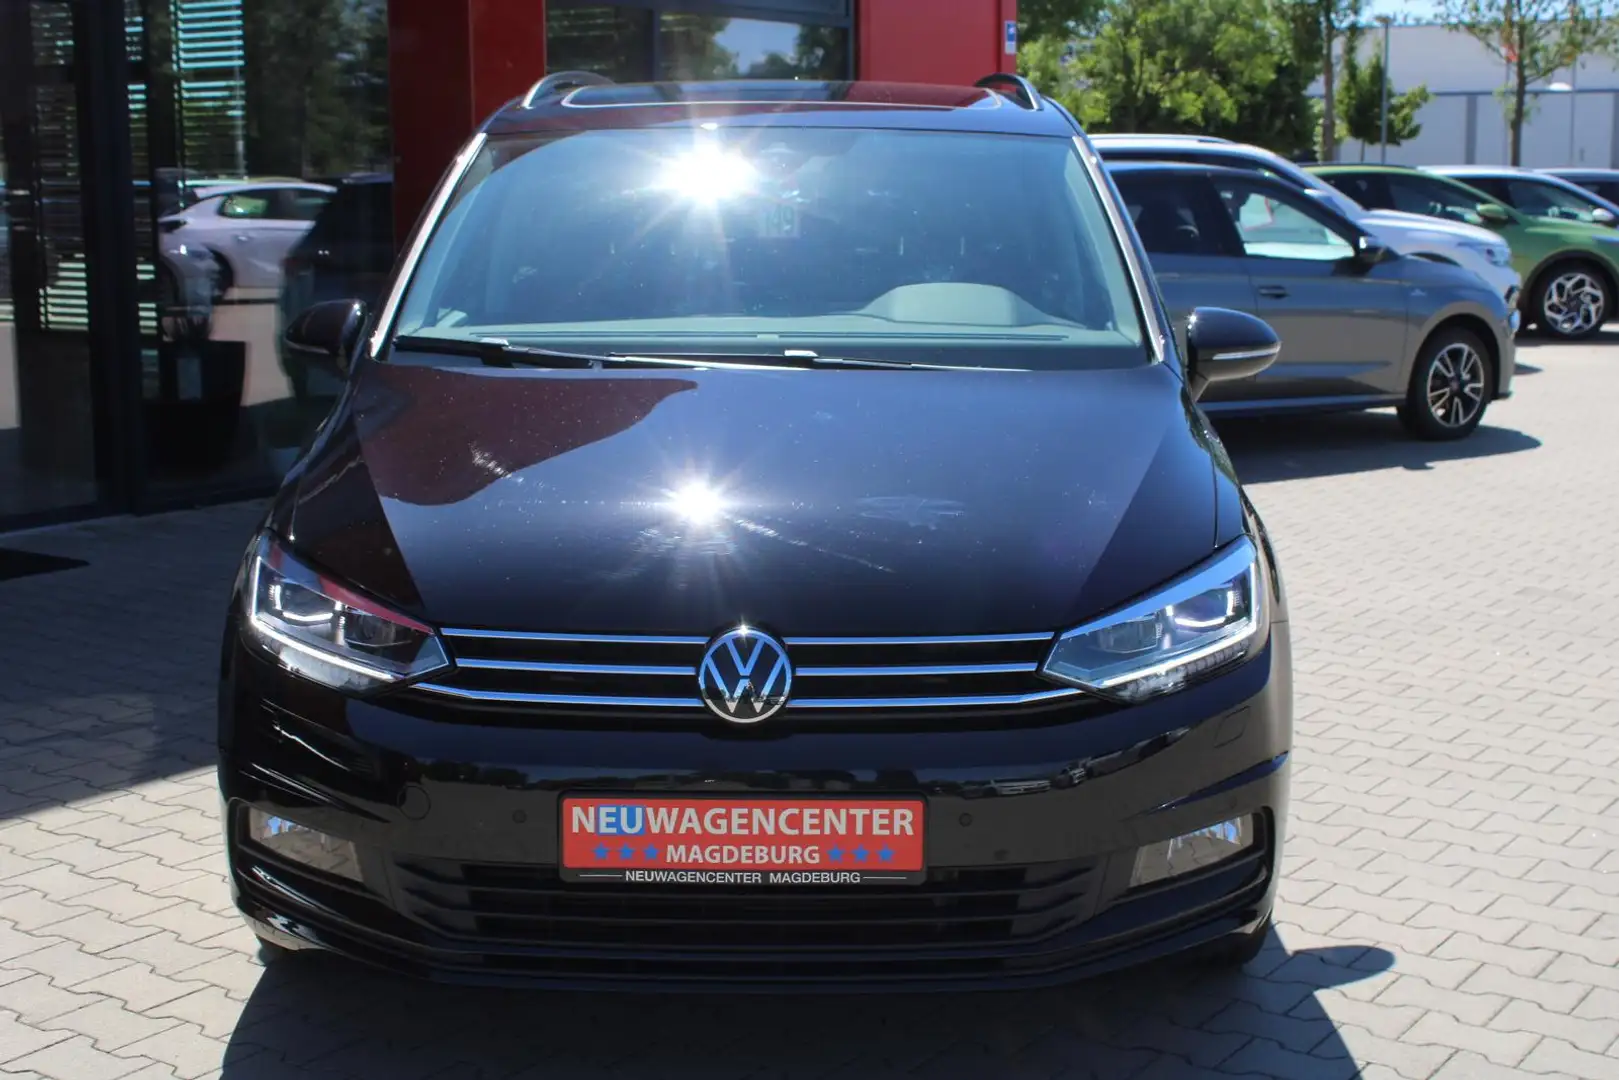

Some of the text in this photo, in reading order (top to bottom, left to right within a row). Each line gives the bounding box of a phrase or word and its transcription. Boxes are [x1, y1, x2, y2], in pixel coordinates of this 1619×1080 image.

[572, 806, 914, 835] NEUWAGENCENTER
[666, 844, 820, 864] MAGDEBURG
[625, 870, 861, 883] NEUWAGENCENTER MAGDEBURG
